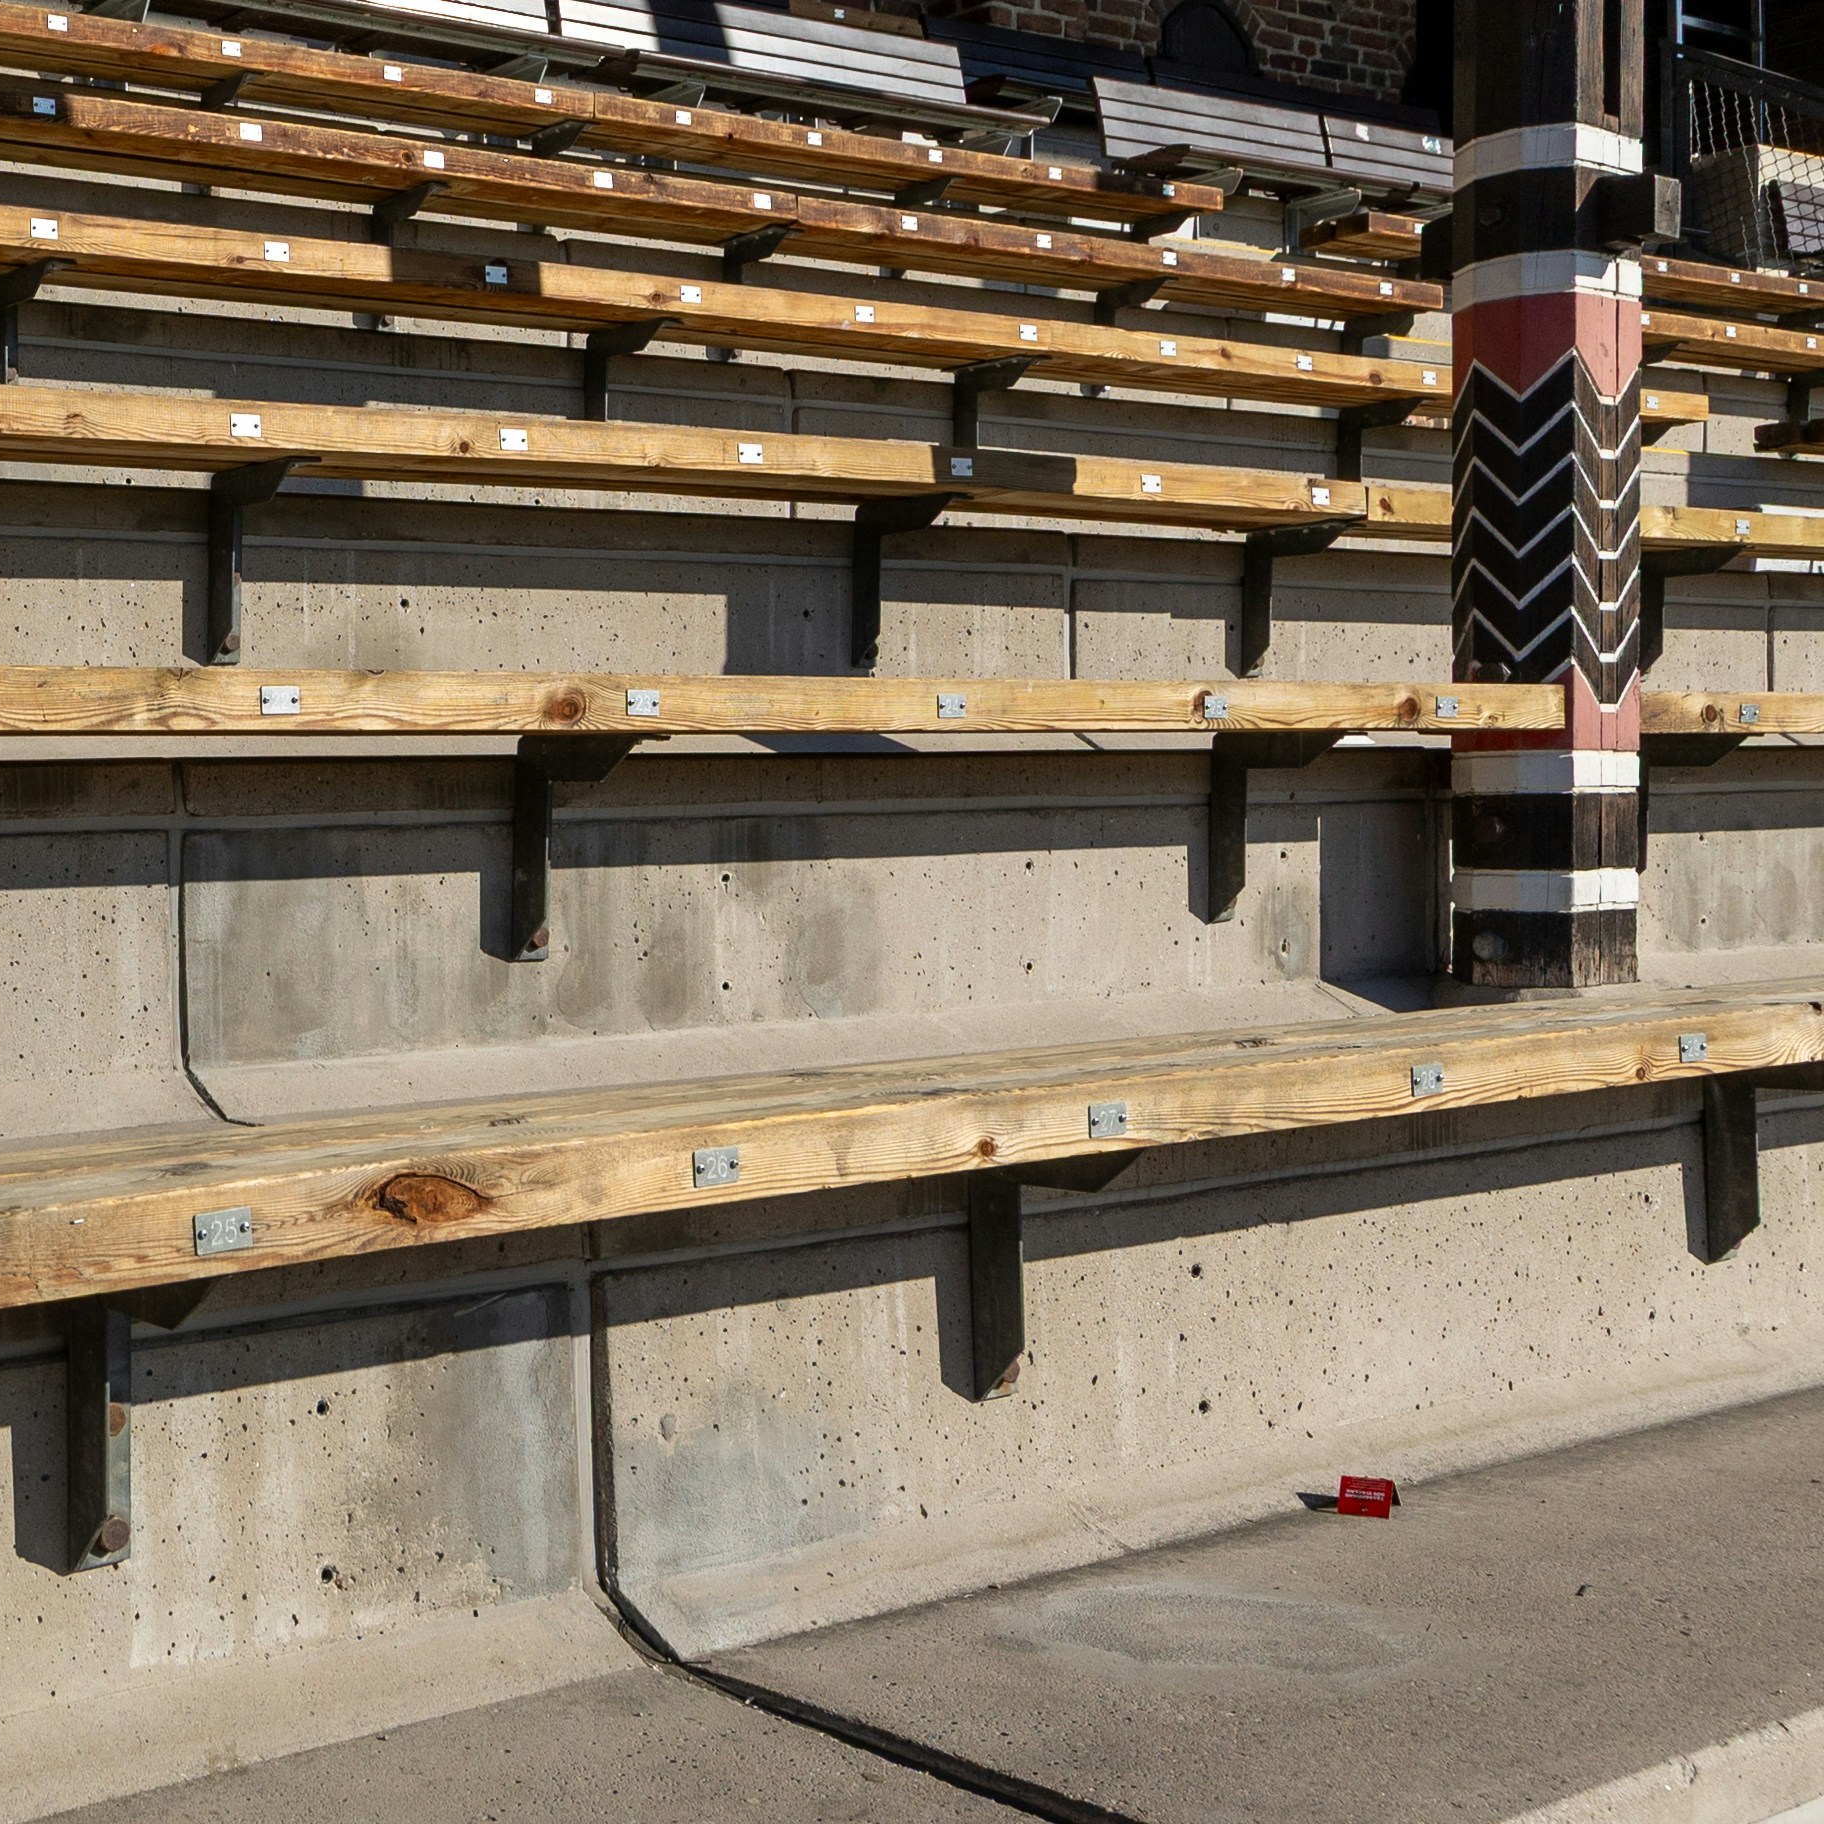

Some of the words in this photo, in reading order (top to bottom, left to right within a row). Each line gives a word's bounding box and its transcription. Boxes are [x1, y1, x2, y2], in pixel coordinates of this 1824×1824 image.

[271, 692, 290, 710] 22
[636, 695, 652, 713] 23
[945, 698, 959, 714] 24
[1421, 1069, 1436, 1089] 28
[1099, 1108, 1117, 1131] 27
[706, 1155, 728, 1179] 26
[211, 1217, 239, 1246] 25
